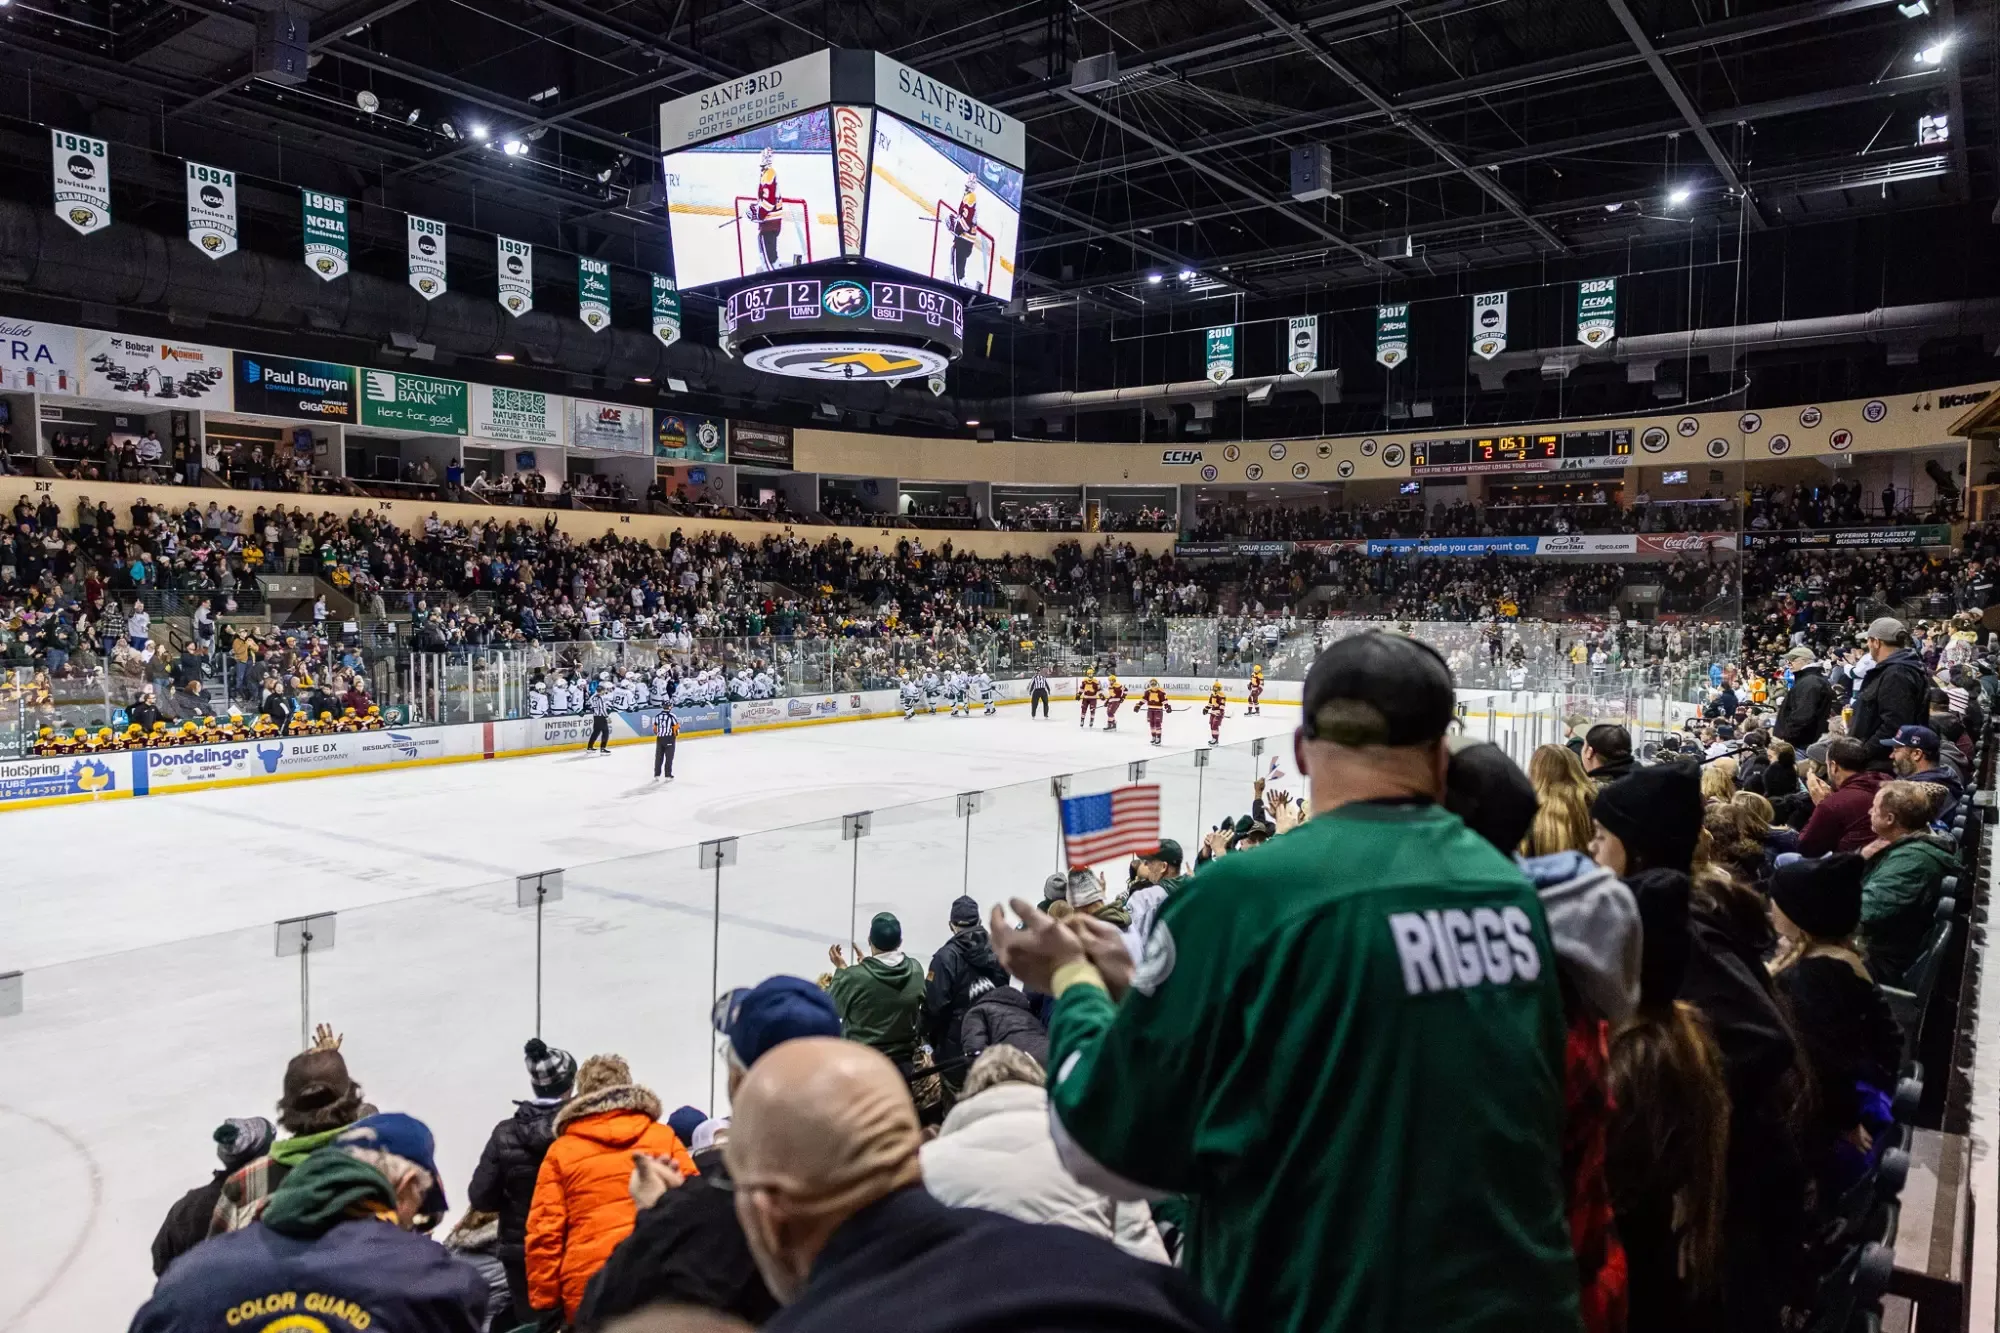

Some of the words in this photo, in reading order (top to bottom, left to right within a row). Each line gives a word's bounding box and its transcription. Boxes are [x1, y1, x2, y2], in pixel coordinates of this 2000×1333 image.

[701, 70, 782, 110] SANFORD
[699, 91, 784, 125] ORTHOPEDICS
[899, 68, 1002, 135] SANFORD
[688, 119, 732, 140] SPORTS
[738, 98, 798, 124] MEDICINE
[922, 110, 983, 147] HEALTH
[56, 132, 104, 157] 1993
[70, 165, 95, 176] NCAA
[189, 165, 232, 187] 1994
[57, 178, 96, 191] Division
[56, 192, 108, 211] CHAMPIONS
[202, 194, 224, 204] NCAA
[305, 192, 345, 214] 1995
[191, 206, 225, 218] Division
[189, 221, 235, 236] CHAMPIONS
[306, 214, 345, 232] NCHA
[410, 218, 443, 236] 1995
[307, 227, 345, 240] Conference
[306, 244, 347, 260] CHAMPIONS
[420, 243, 436, 252] NCAA
[500, 240, 530, 256] 1997
[411, 254, 438, 265] Division
[410, 266, 445, 280] CHAMPIONS
[508, 263, 523, 271] NCAA
[580, 258, 608, 276] 2004
[500, 273, 524, 283] Division
[1581, 279, 1614, 293] 2024
[581, 291, 608, 301] Conference
[745, 288, 773, 309] 05.7
[798, 284, 809, 302] 2
[882, 286, 893, 304] 2
[918, 292, 946, 313] 05.7
[1477, 294, 1504, 307] 2021
[1581, 296, 1613, 307] CCHA
[755, 310, 760, 319] 2
[793, 307, 814, 316] UMN
[877, 309, 895, 318] BSU
[1380, 306, 1406, 319] 2017
[931, 314, 936, 323] 2
[1290, 317, 1315, 329] 2010
[1482, 316, 1499, 324] NCAA
[1208, 328, 1232, 339] 2010
[125, 340, 154, 353] Bobcat
[264, 368, 294, 384] Paul
[298, 372, 348, 392] Bunyan
[265, 384, 325, 396] COMMUNICATIONS
[398, 378, 462, 397] SECURITY
[398, 390, 437, 405] BANK
[299, 401, 348, 415] GIGAZONE
[600, 406, 621, 421] ACE
[377, 406, 403, 418] Here
[406, 408, 425, 421] for
[430, 414, 453, 426] good
[492, 410, 527, 422] NATURE'S
[528, 415, 546, 424] EDGE
[481, 424, 520, 434] LANDSCAPING
[526, 430, 556, 438] IRRIGATION
[492, 419, 520, 427] GARDEN
[521, 422, 546, 430] CENTER
[1500, 436, 1525, 450] 05.7
[1546, 443, 1556, 455] 2
[1617, 444, 1629, 454] 11
[1162, 451, 1203, 464] CCHA
[1484, 447, 1493, 459] 2
[1519, 450, 1526, 460] 2
[1885, 530, 1908, 538] LATEST
[1418, 543, 1447, 553] people
[1450, 545, 1466, 554] you
[1595, 543, 1630, 551] otpco.com
[614, 695, 625, 705] 21
[545, 719, 582, 730] INTERNET
[545, 730, 560, 740] UP
[563, 728, 577, 738] TO
[292, 744, 319, 755] BLUE
[323, 743, 337, 752] OX
[362, 743, 392, 751] RESOLVE
[149, 748, 249, 767] Dondelinger
[280, 756, 311, 765] MOVING
[313, 753, 349, 763] COMPANY
[1, 763, 60, 778] HotSpring
[0, 780, 25, 788] TUBS
[1389, 906, 1541, 995] RIGGS
[226, 1291, 297, 1326] COLOR
[304, 1292, 371, 1330] GUARD
